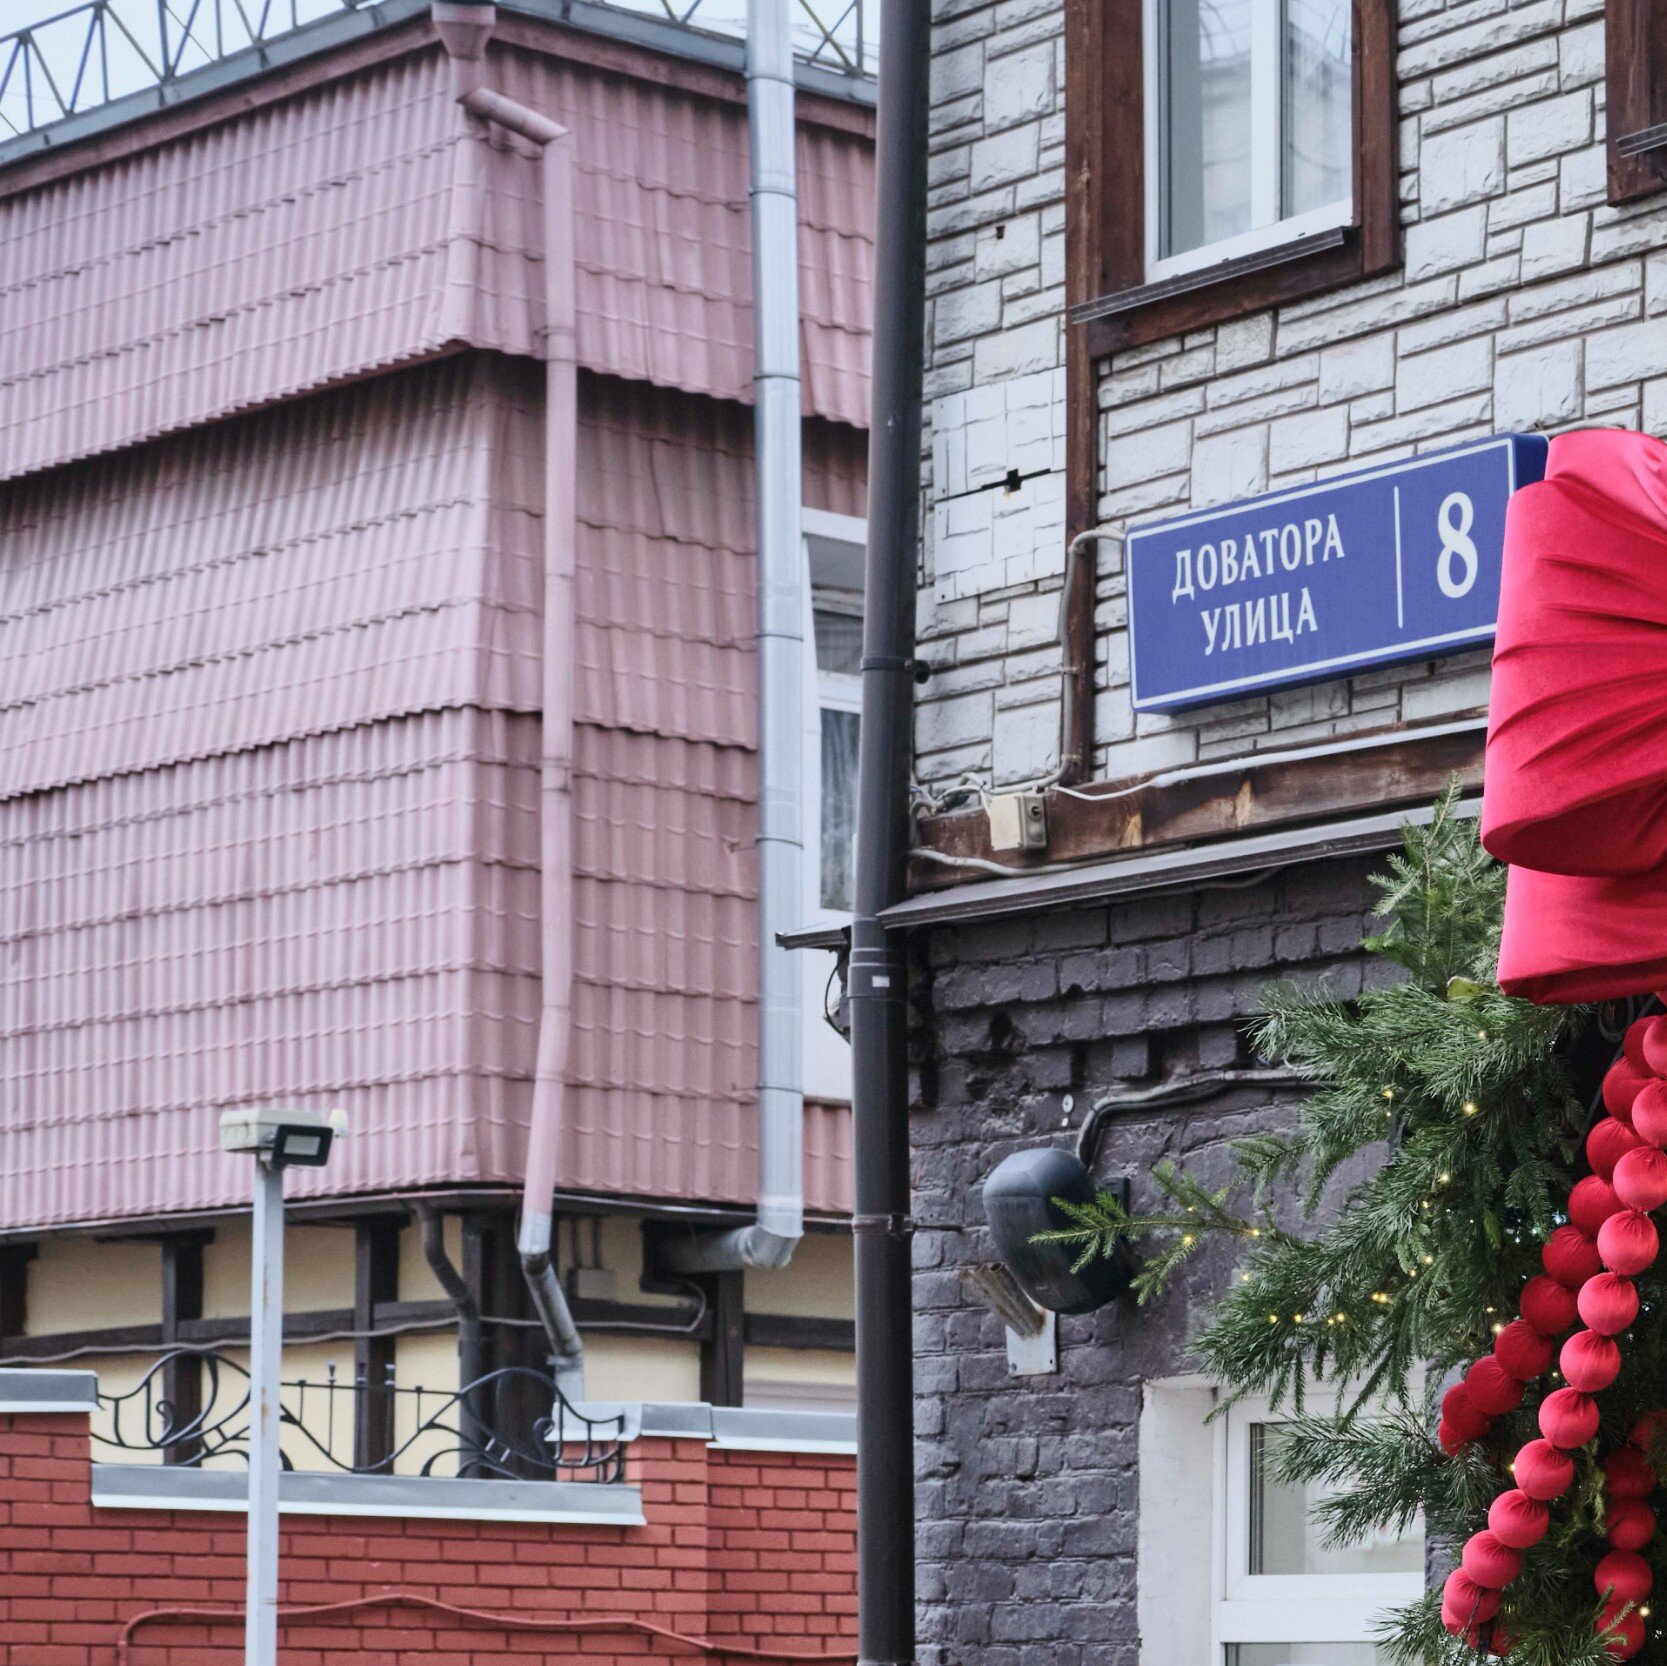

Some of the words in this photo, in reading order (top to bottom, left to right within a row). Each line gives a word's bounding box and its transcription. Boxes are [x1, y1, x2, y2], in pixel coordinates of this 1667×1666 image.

[1171, 512, 1346, 605] ДОВАТОРА
[1436, 491, 1479, 599] 8
[1200, 587, 1318, 656] УЛИЦА
